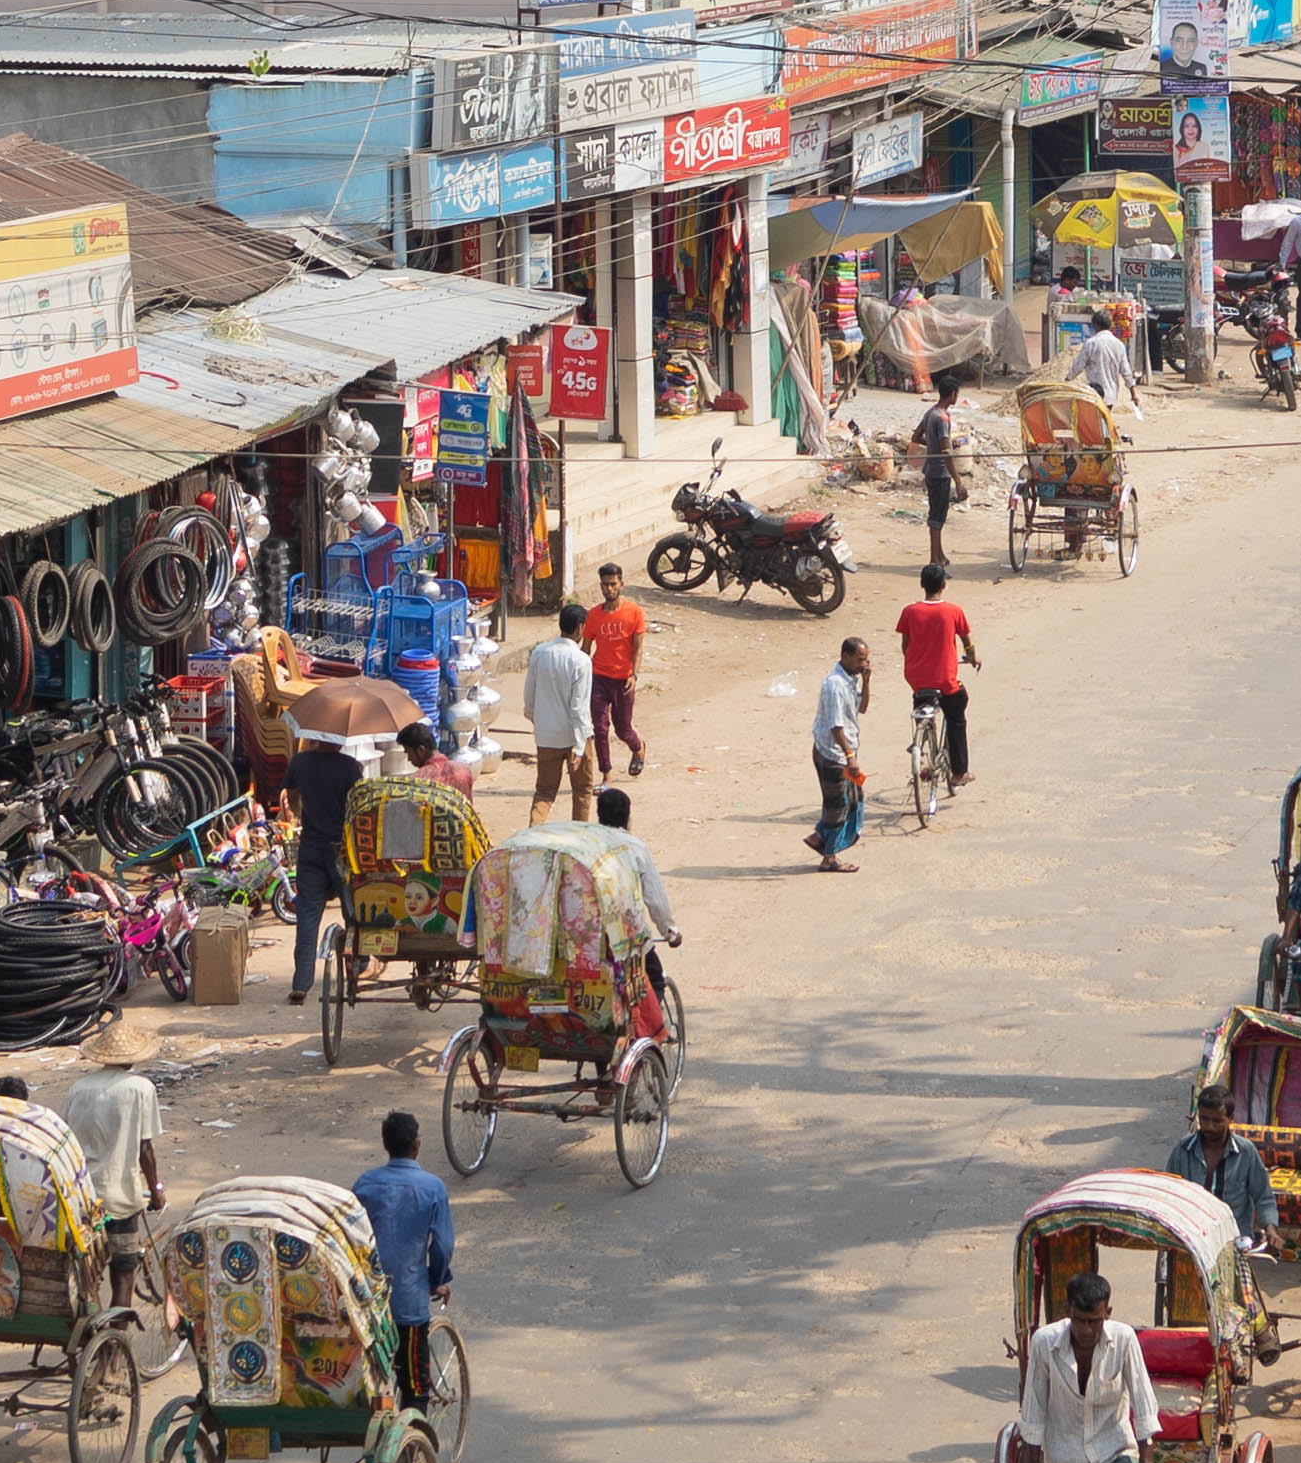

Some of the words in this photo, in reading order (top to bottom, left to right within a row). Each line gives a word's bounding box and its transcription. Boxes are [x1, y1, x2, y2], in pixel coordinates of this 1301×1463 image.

[583, 76, 634, 113] প্রবাল
[638, 66, 696, 108] ফ্যাশন
[575, 132, 611, 172] সাদা
[616, 127, 657, 161] কালো
[669, 106, 752, 171] গীতাশ্রী
[573, 994, 605, 1011] 2017
[312, 1357, 351, 1379] 2017
